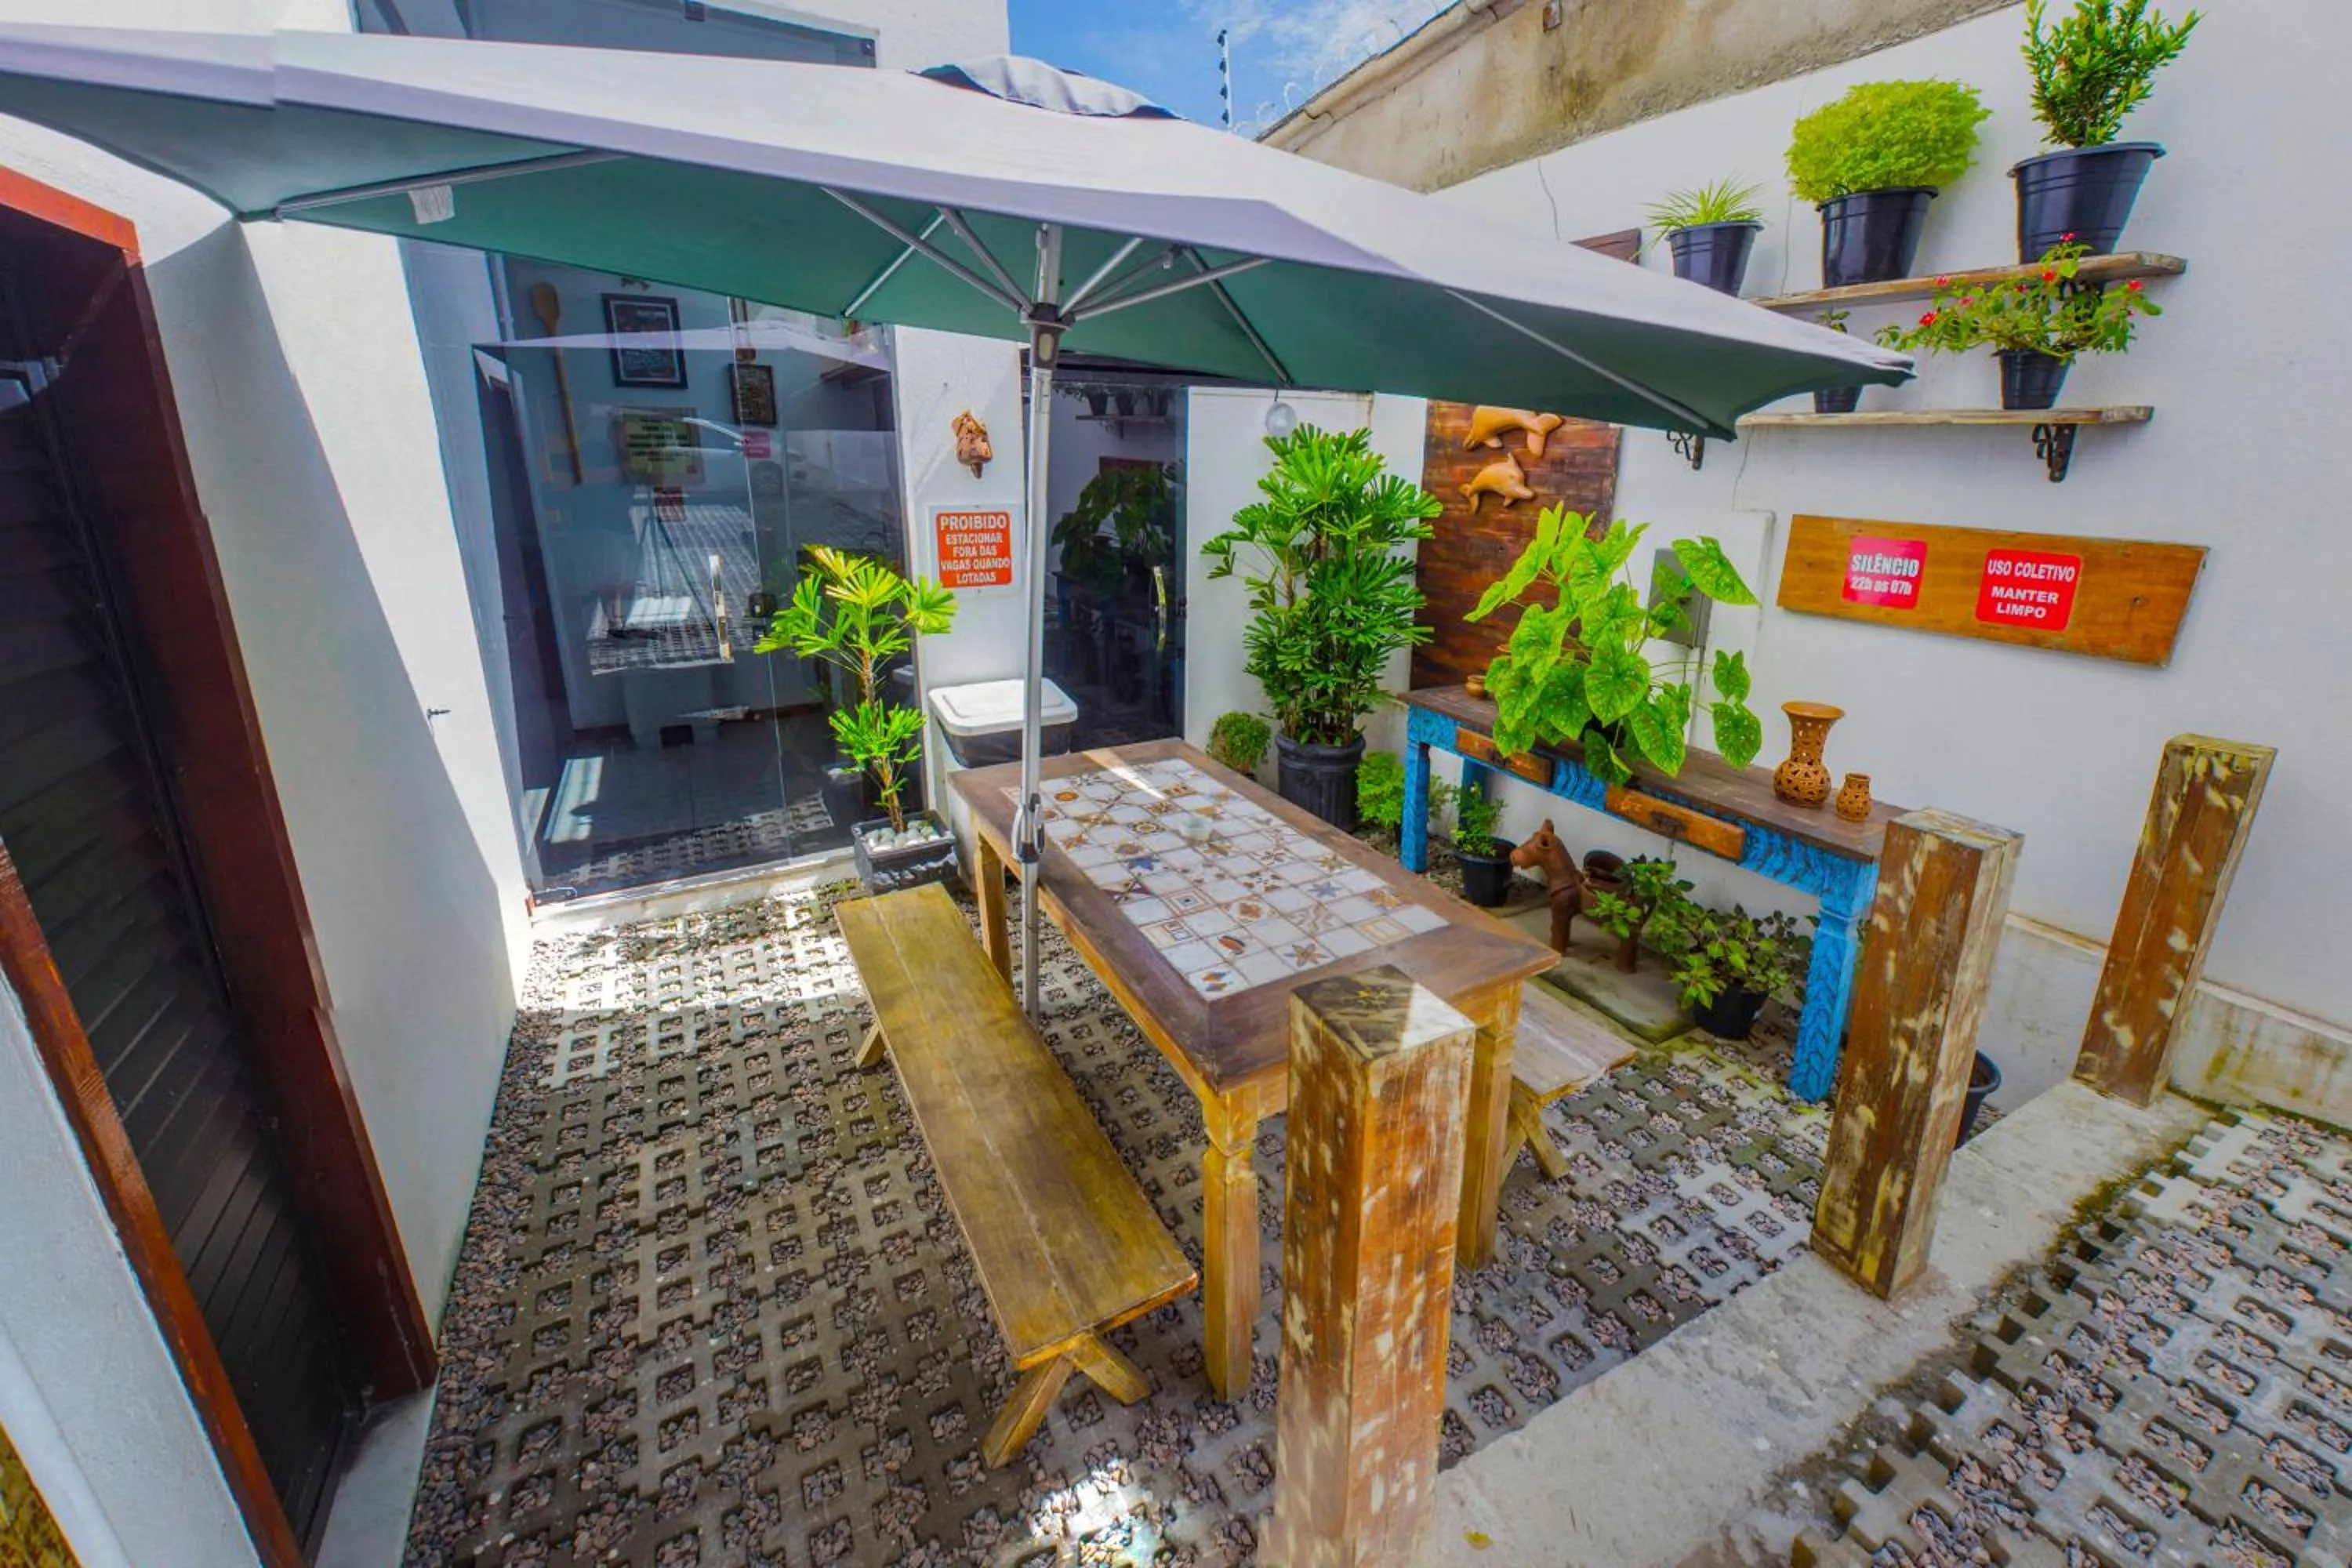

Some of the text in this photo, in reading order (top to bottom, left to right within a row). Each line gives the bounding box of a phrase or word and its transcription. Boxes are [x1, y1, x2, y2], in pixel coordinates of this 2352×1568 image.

[941, 514, 1007, 530] PROIBIDO
[946, 533, 1004, 545] ESTACIONAR
[953, 545, 997, 557] FORA DAS
[941, 557, 1011, 571] VAGAS QUANDO
[1851, 553, 1919, 577] SILÊNCIO
[1987, 559, 2075, 583] USO COLETIVO
[956, 572, 996, 584] LOTADAS
[1991, 586, 2060, 604] MANTER
[1996, 602, 2047, 619] LIMPO
